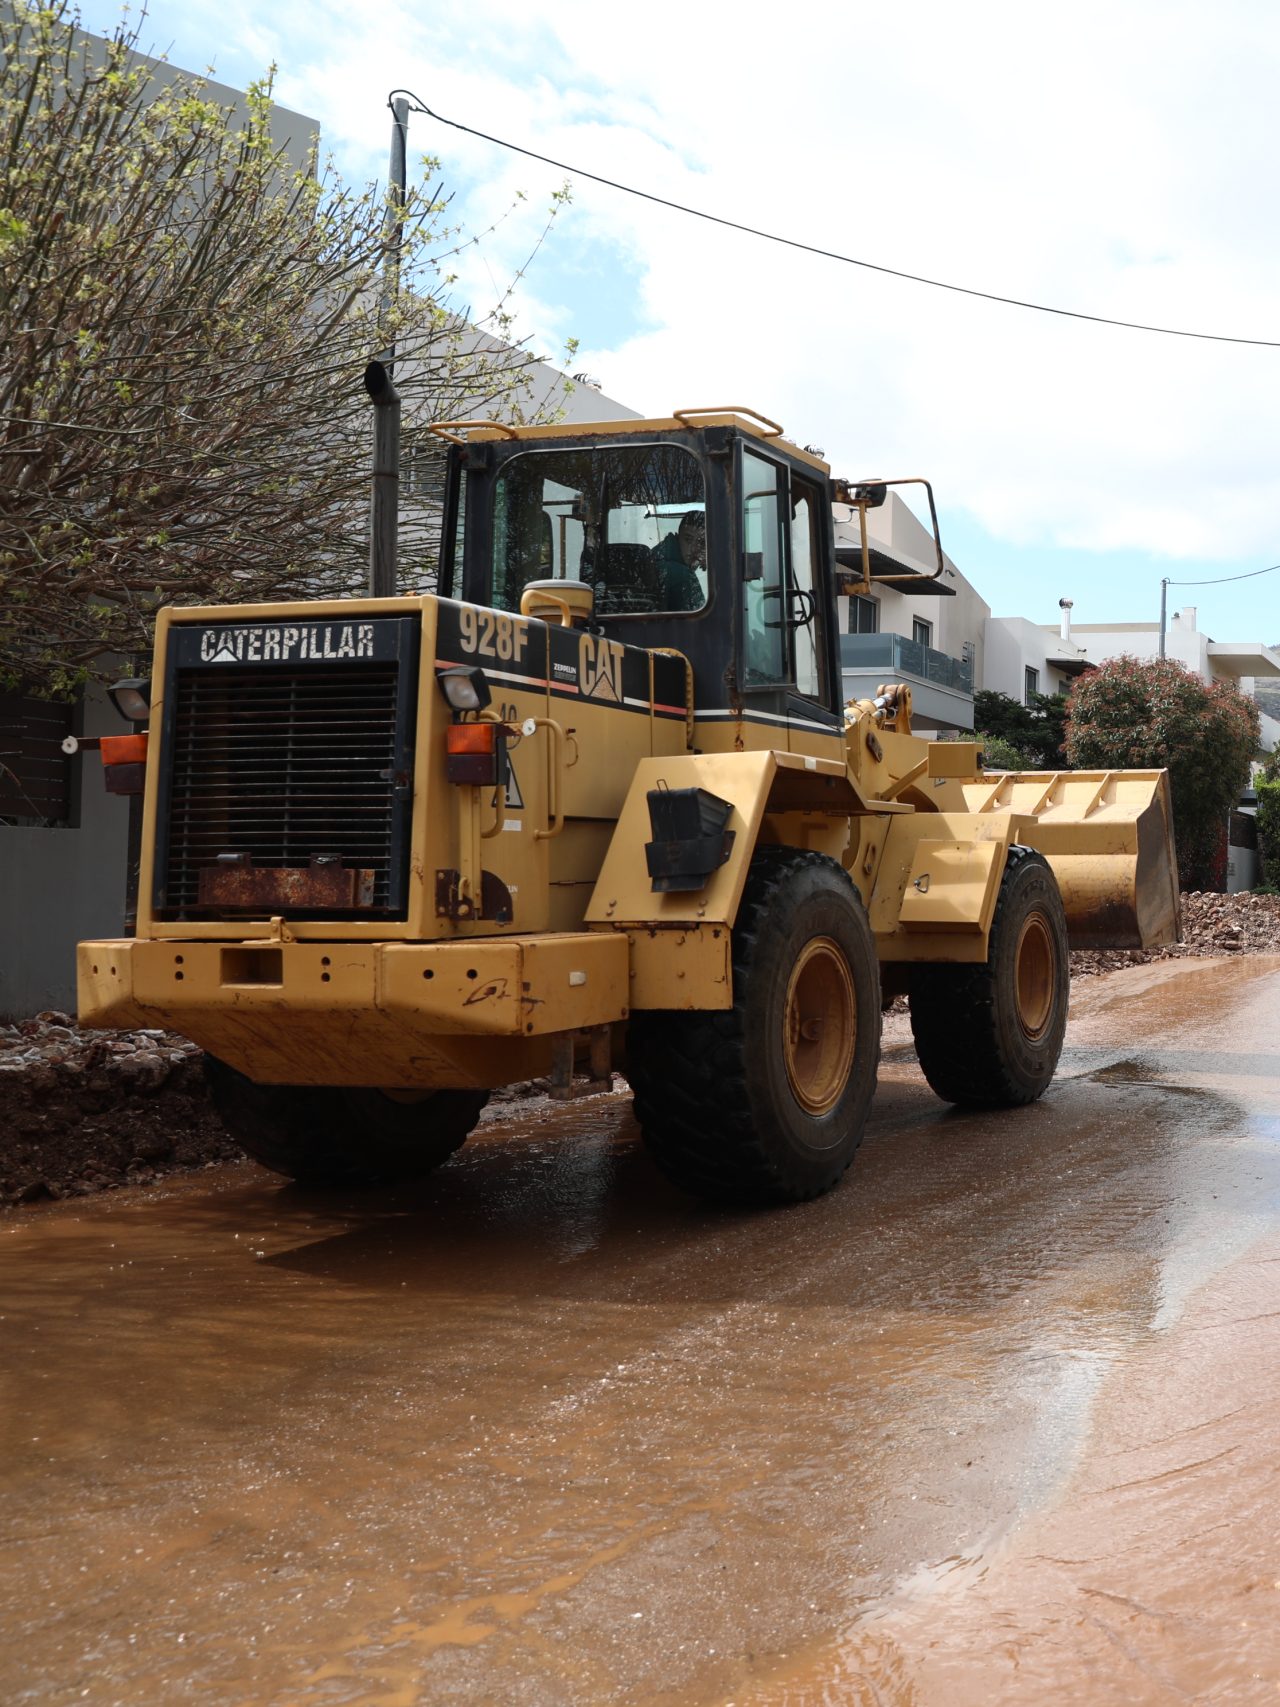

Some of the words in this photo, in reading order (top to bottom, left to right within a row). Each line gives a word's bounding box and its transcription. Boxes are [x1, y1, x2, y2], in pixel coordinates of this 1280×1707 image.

[200, 624, 375, 662] CATERPILLAR
[459, 607, 529, 662] 928F
[578, 632, 625, 703] CAT
